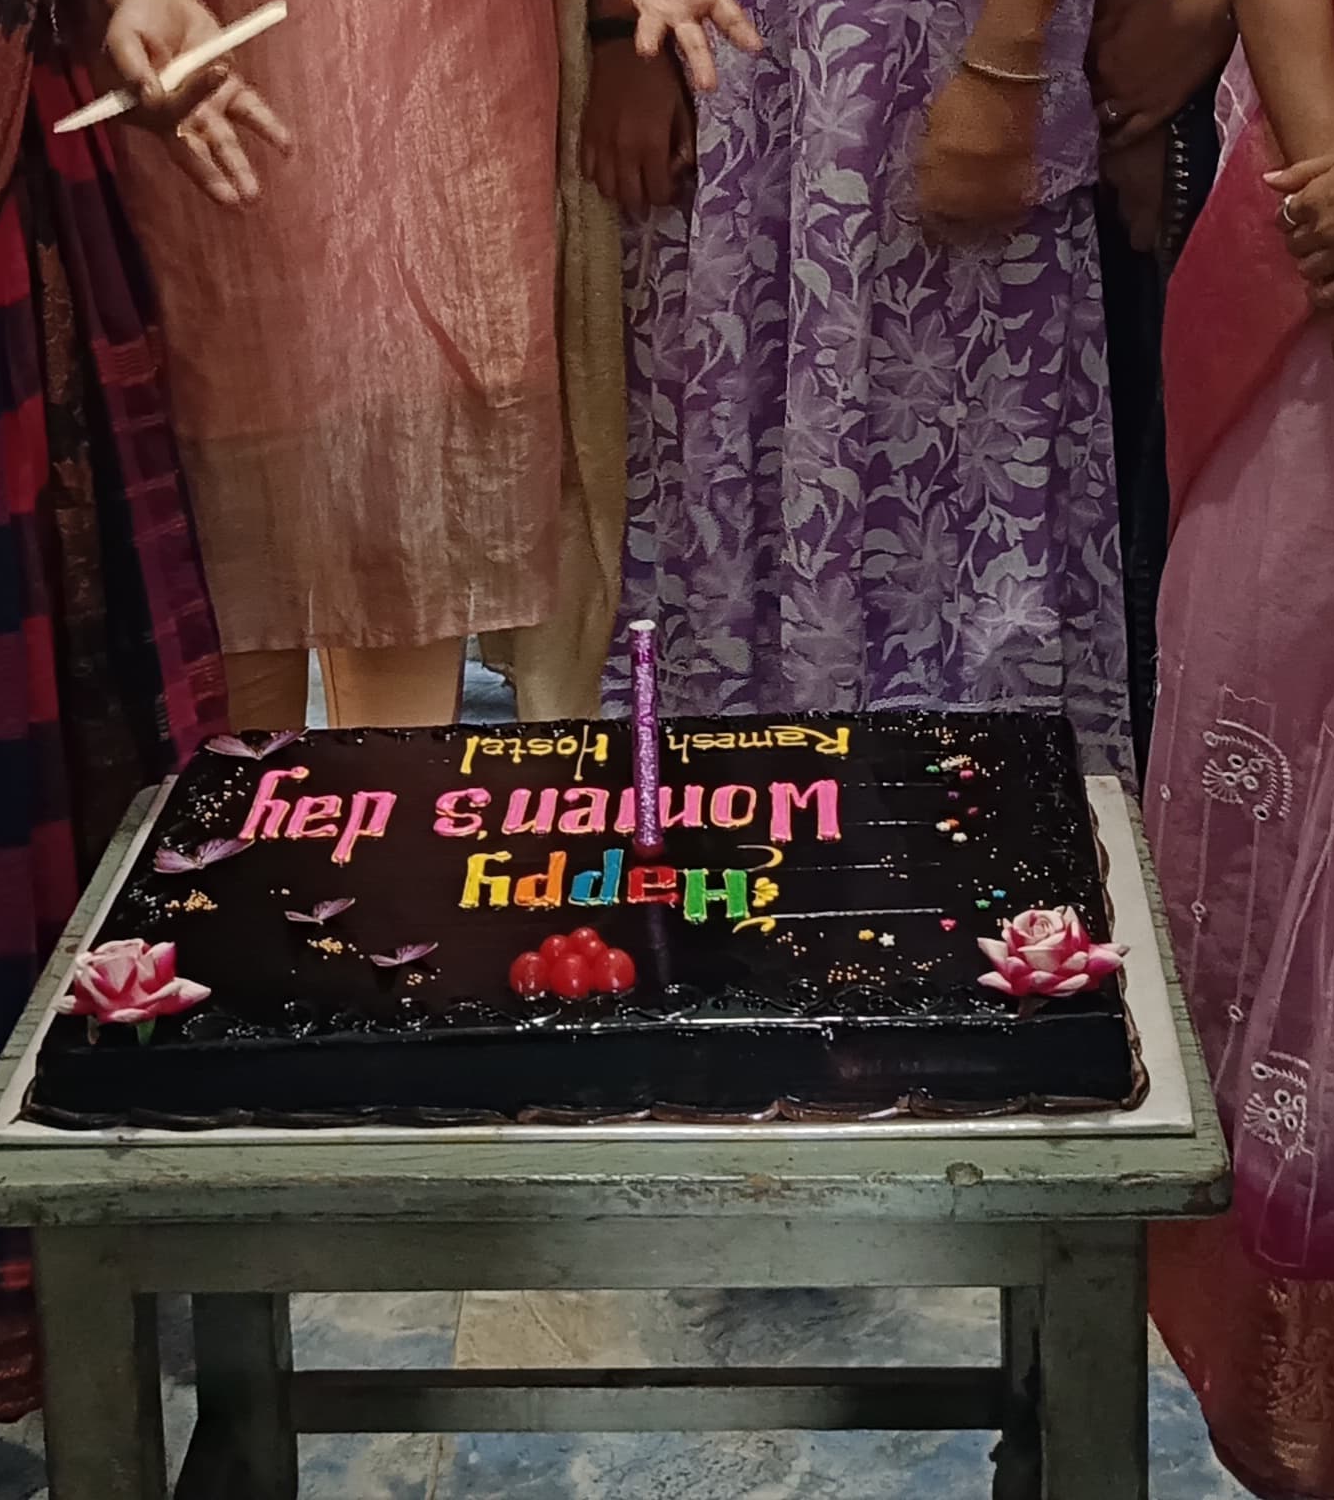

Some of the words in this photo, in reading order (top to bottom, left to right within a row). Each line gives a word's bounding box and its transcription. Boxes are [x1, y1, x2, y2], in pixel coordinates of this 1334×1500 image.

[459, 723, 610, 782] Hostel
[666, 724, 850, 765] Ramesh
[237, 765, 399, 866] day
[459, 847, 751, 923] Happy
